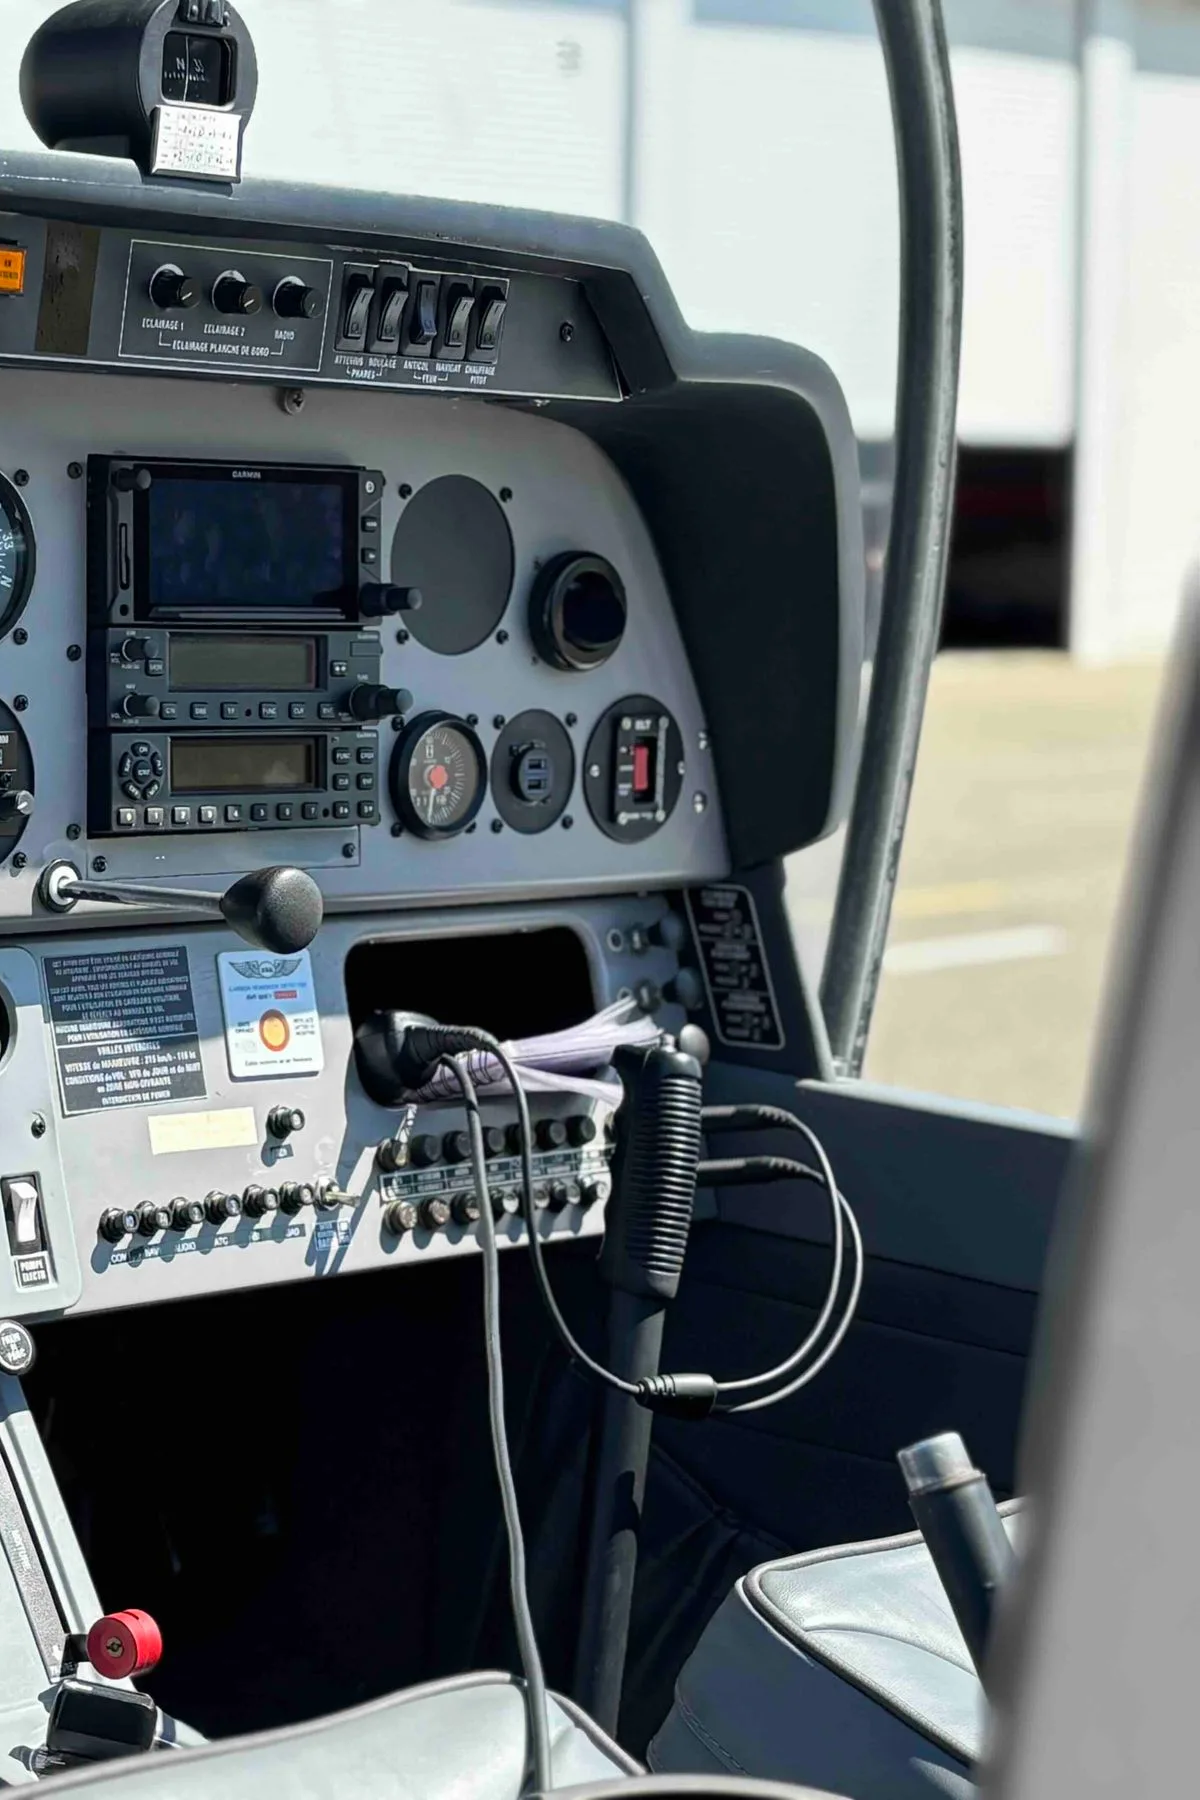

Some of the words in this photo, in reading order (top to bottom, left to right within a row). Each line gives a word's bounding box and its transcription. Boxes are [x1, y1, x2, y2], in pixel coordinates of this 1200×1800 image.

[142, 318, 179, 331] ECLAIRAGE
[204, 323, 239, 336] ECLAIRAGE
[274, 329, 295, 341] RADIO
[2, 531, 14, 550] 33
[0, 575, 13, 588] N
[634, 718, 651, 731] ELT
[64, 1061, 92, 1073] VITESSE
[152, 1066, 169, 1077] JOUR
[144, 1247, 160, 1257] NAV
